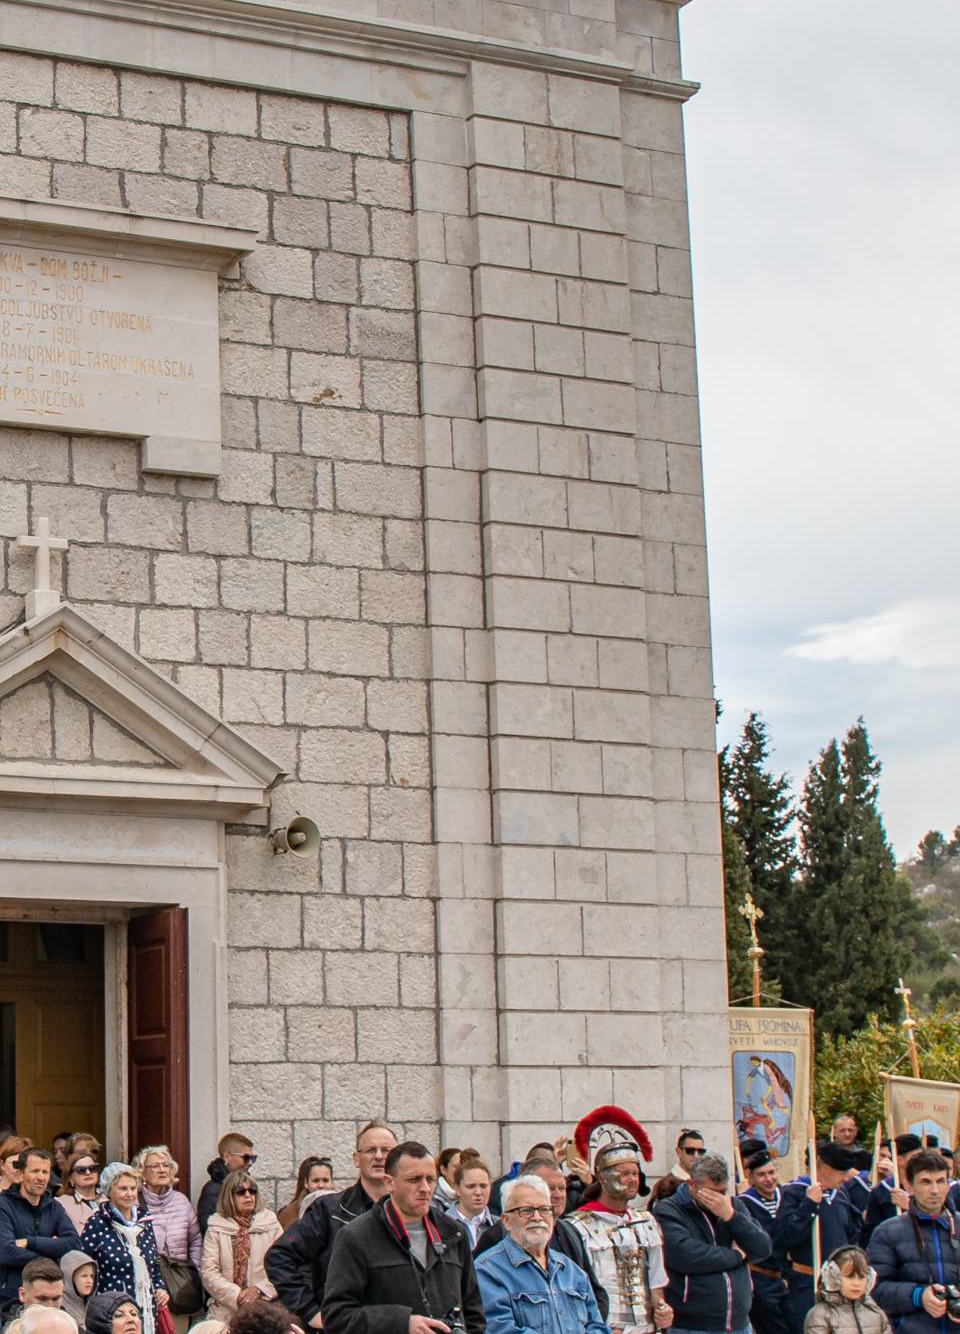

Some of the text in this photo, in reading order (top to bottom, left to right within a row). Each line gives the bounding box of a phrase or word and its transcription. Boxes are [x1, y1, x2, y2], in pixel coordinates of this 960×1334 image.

[40, 257, 67, 279] DOM
[72, 259, 109, 283] BOŽJI
[90, 309, 153, 332] OTVORENA
[13, 385, 86, 411] POSVEĆENA
[729, 1018, 752, 1032] UPA
